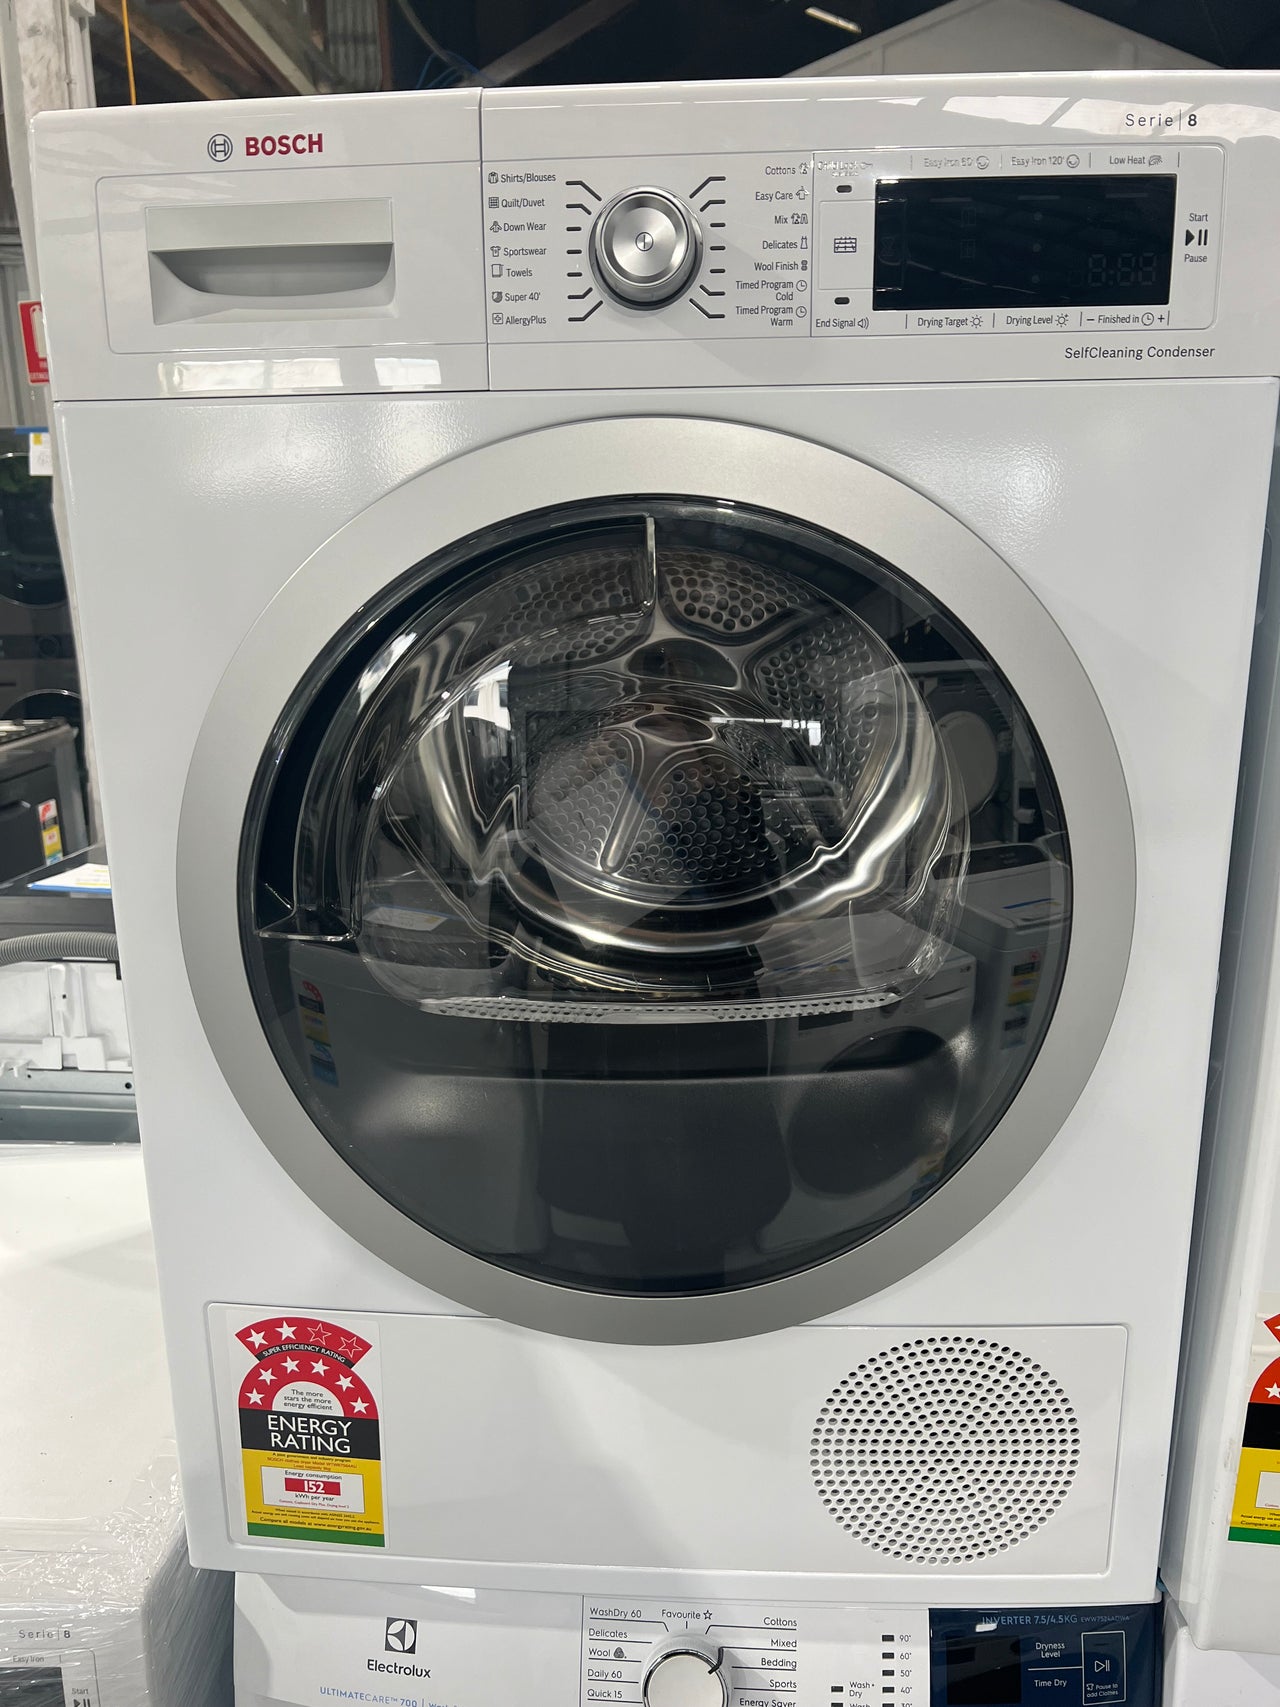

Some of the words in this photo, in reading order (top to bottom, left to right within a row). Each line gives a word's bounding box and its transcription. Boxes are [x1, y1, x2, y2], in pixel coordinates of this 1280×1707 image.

[1125, 113, 1173, 127] Serie
[1187, 113, 1197, 127] 8
[245, 133, 323, 156] BOSCH
[1011, 156, 1030, 167] Easy
[1031, 156, 1047, 166] Iron
[1109, 155, 1125, 165] Low
[1127, 155, 1146, 165] Heat
[765, 165, 796, 176] Cottons
[500, 172, 557, 184] Shirts/Blouses
[755, 191, 773, 202] Easy
[775, 190, 793, 200] Care
[501, 198, 545, 209] Quilt/Duvet
[774, 215, 788, 225] Mix
[1189, 212, 1208, 222] Start
[503, 222, 524, 232] Down
[526, 221, 547, 231] Wear
[762, 239, 798, 250] Delicates
[503, 246, 547, 258] Sportswear
[1184, 254, 1208, 263] Pause
[754, 261, 773, 271] Wool
[775, 261, 799, 271] Finish
[505, 267, 533, 278] Towels
[735, 280, 758, 291] Timed
[760, 280, 794, 293] Program
[504, 292, 527, 303] Super
[775, 291, 794, 301] Cold
[735, 305, 758, 316] Timed
[760, 305, 794, 318] Program
[505, 315, 547, 326] AllergyPlus
[770, 317, 794, 327] Warm
[815, 318, 830, 328] End
[831, 318, 856, 330] Signal
[917, 317, 944, 329] Drying
[944, 316, 968, 328] Target
[1006, 315, 1032, 327] Drying
[1033, 315, 1053, 325] Level
[1098, 314, 1130, 324] Finished
[1132, 314, 1140, 323] in
[1064, 346, 1143, 360] SelfCleaning
[1147, 345, 1216, 358] Condenser
[262, 1346, 282, 1357] SUPER
[282, 1343, 320, 1353] EFFICIENCY
[320, 1348, 346, 1363] RATING
[283, 1401, 305, 1410] energy
[307, 1402, 333, 1411] efficient
[267, 1414, 352, 1437] ENERGY
[270, 1432, 351, 1454] RATING
[284, 1470, 304, 1478] Energy
[305, 1472, 342, 1481] consumption
[304, 1480, 325, 1493] 152
[589, 1607, 629, 1619] WashDry
[630, 1609, 642, 1618] 60
[661, 1609, 701, 1620] Favourite
[763, 1616, 797, 1627] Cottons
[982, 1615, 1032, 1626] INVERTER
[1033, 1614, 1078, 1625] 7.5/4.5KG
[18, 1629, 54, 1639] Serie
[63, 1629, 71, 1639] 8
[588, 1627, 628, 1639] Delicates
[770, 1638, 797, 1648] Mixed
[1035, 1642, 1066, 1652] Dryness
[588, 1647, 611, 1657] Wool
[1041, 1650, 1061, 1659] Level
[367, 1658, 432, 1679] Electrolux
[761, 1657, 797, 1669] Bedding
[587, 1668, 609, 1680] Daily
[611, 1670, 622, 1679] 60
[769, 1679, 797, 1689] Sports
[849, 1681, 871, 1689] Wash
[1034, 1679, 1052, 1687] Time
[1053, 1679, 1068, 1688] Dry
[1095, 1683, 1111, 1691] Pause
[71, 1687, 89, 1695] Start
[587, 1688, 612, 1698] Quick
[614, 1690, 623, 1699] 15
[849, 1689, 863, 1699] Dry
[1086, 1690, 1098, 1698] add
[1098, 1689, 1119, 1697] Clothes
[399, 1698, 418, 1707] 700
[739, 1697, 770, 1707] Energy
[771, 1699, 796, 1707] Saver
